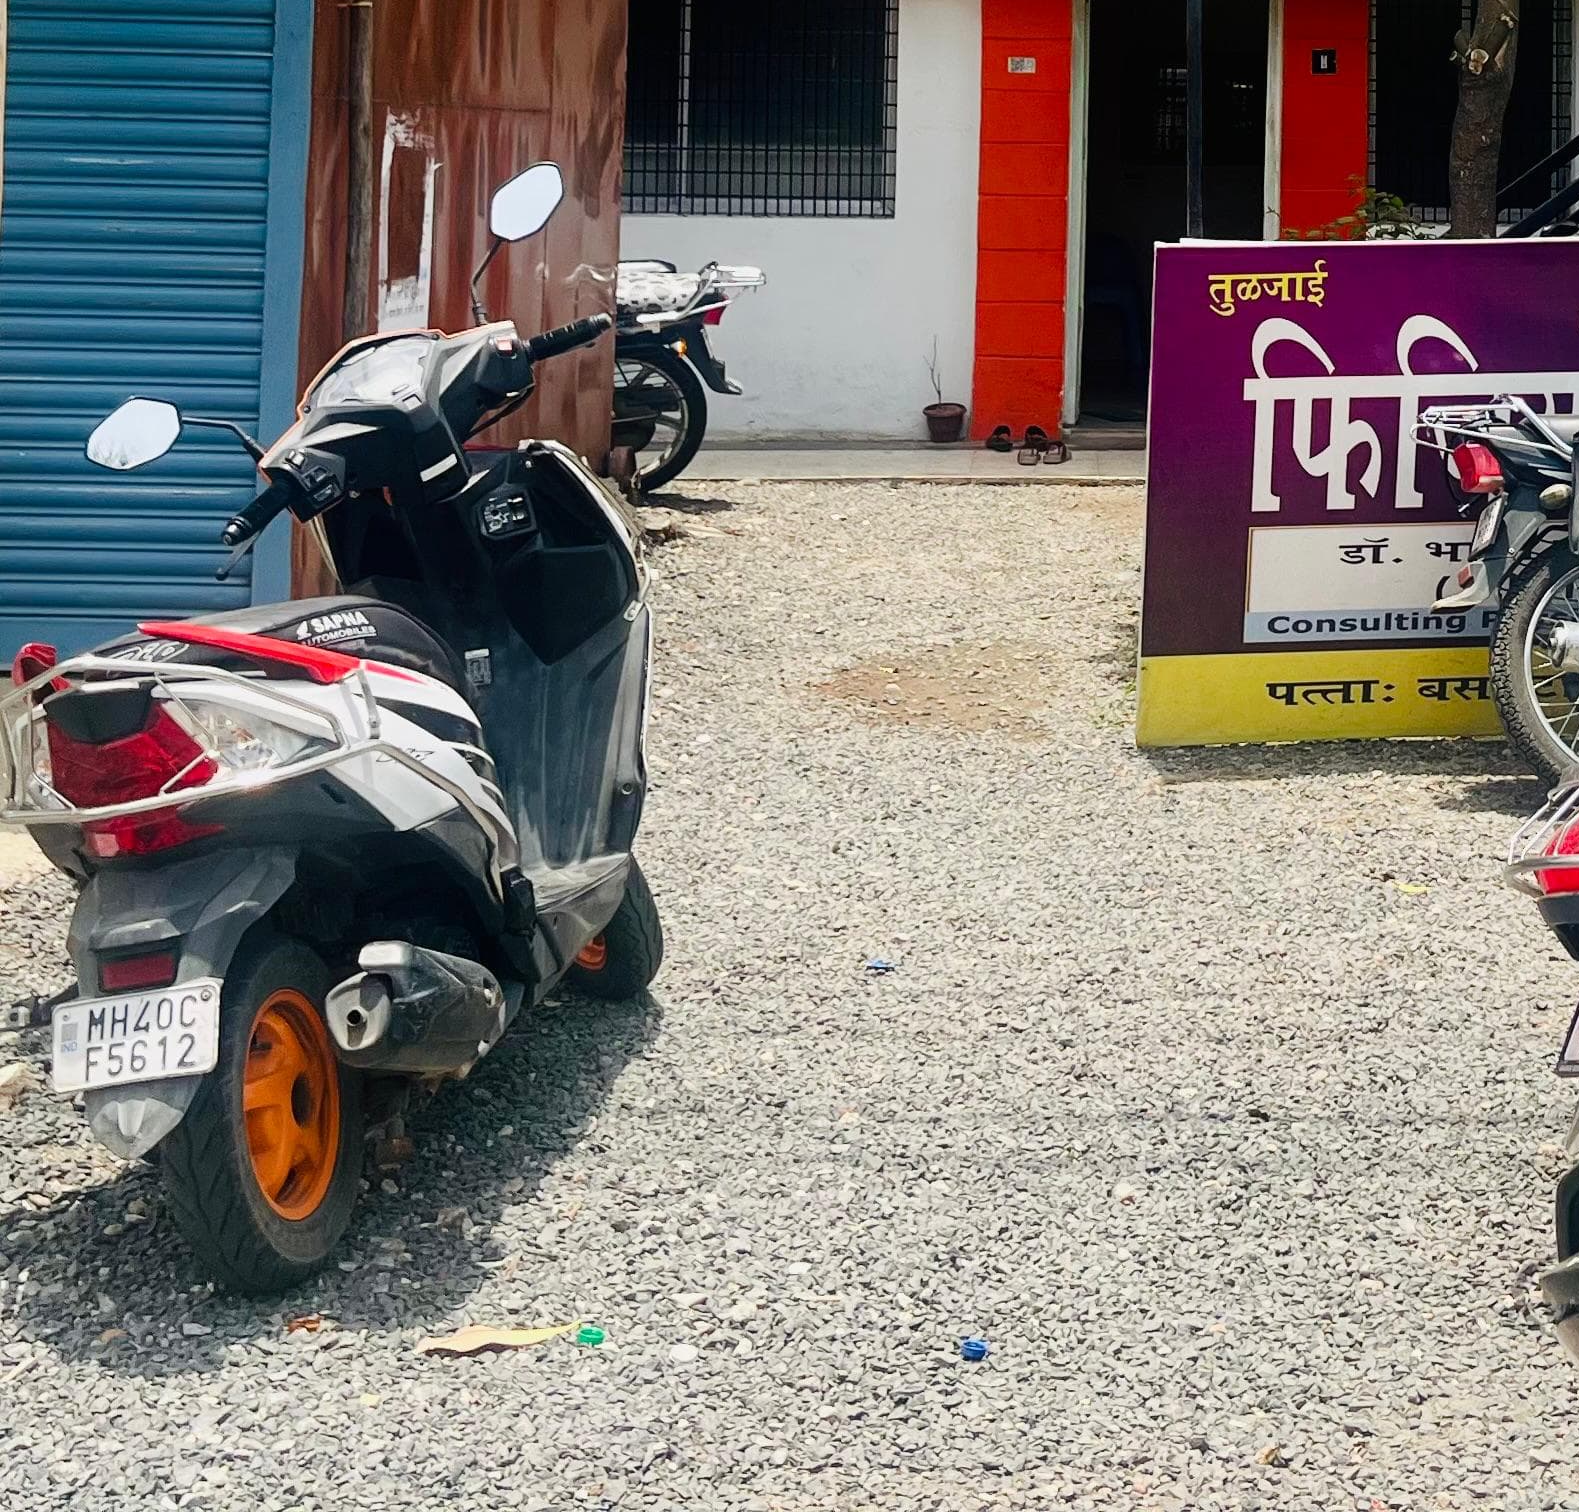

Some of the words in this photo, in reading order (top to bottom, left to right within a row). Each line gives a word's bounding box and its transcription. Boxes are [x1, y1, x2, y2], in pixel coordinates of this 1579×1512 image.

[1207, 259, 1329, 316] तुळजाई
[1339, 537, 1404, 566] डॉ.
[310, 610, 370, 634] SAPNA
[1266, 610, 1467, 636] Consulting
[1417, 675, 1494, 704] बस
[88, 995, 197, 1042] MH40C
[85, 1033, 196, 1082] F5612
